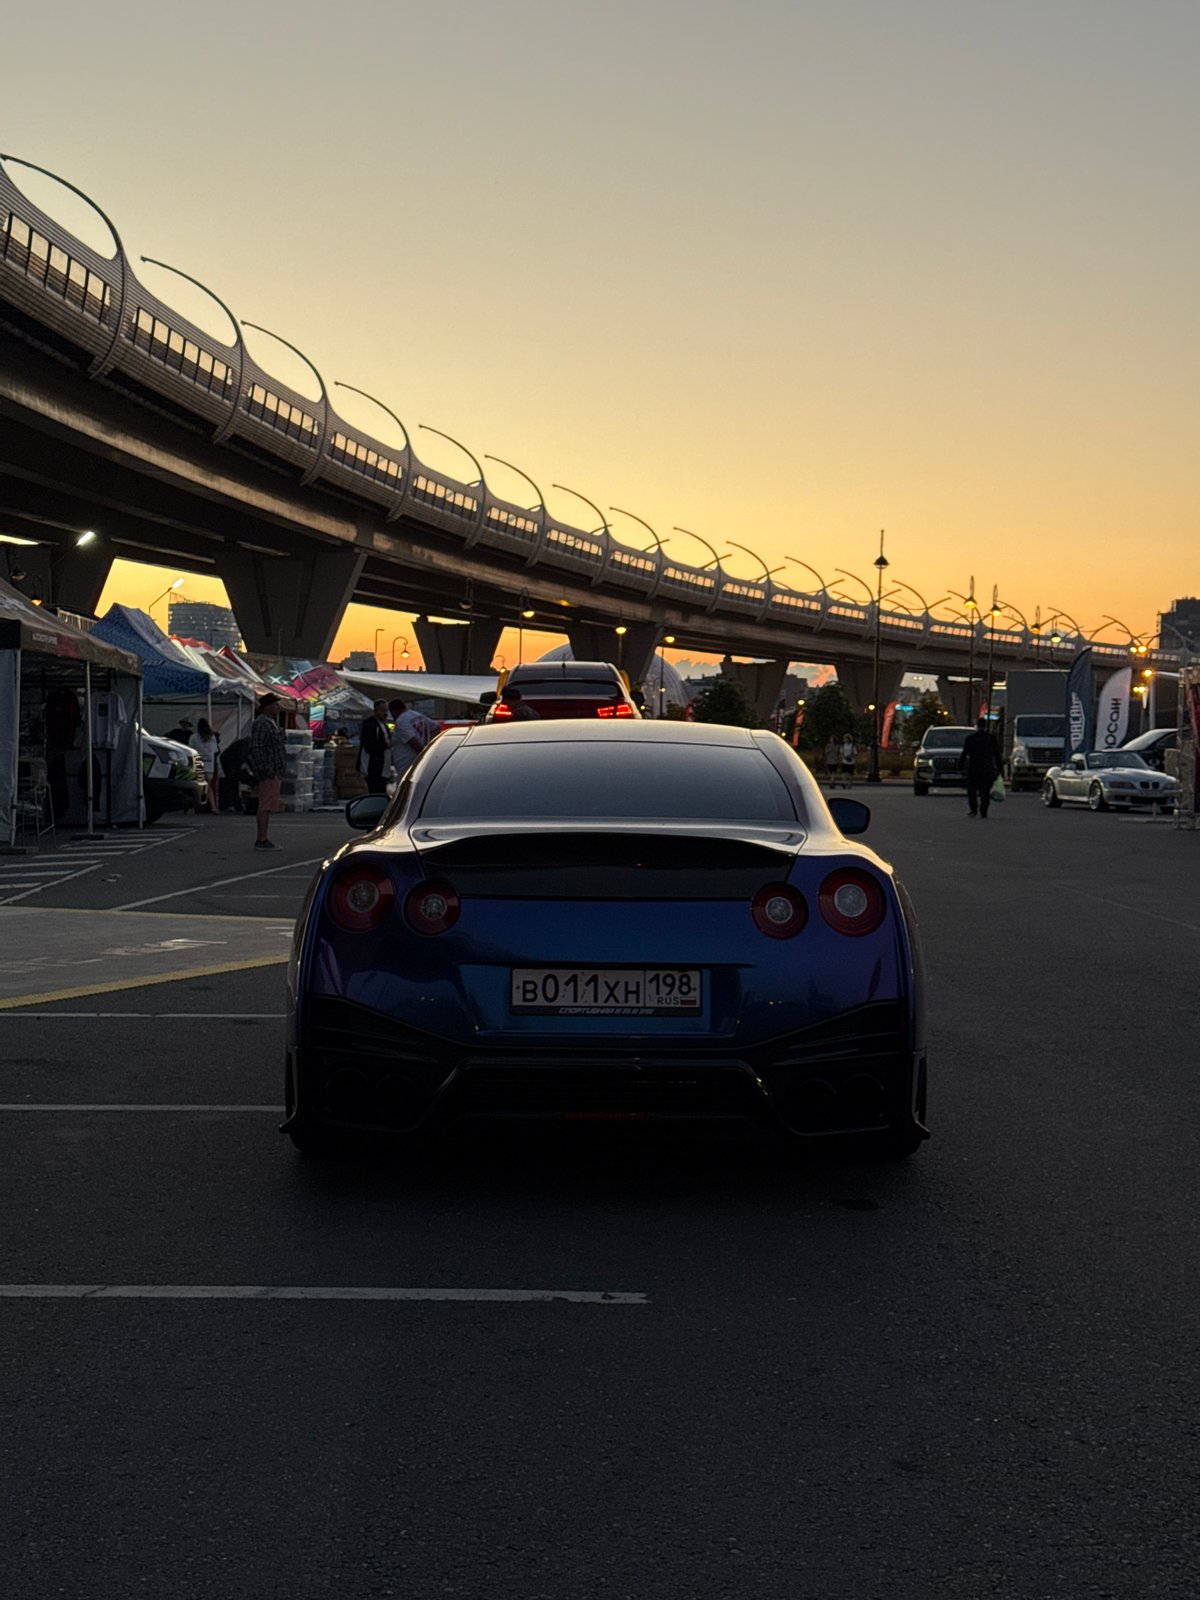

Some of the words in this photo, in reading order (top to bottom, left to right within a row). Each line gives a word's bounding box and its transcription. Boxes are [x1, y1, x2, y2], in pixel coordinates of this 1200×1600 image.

[522, 973, 641, 1004] В011ХН
[648, 973, 692, 996] 198
[657, 996, 679, 1005] RUS
